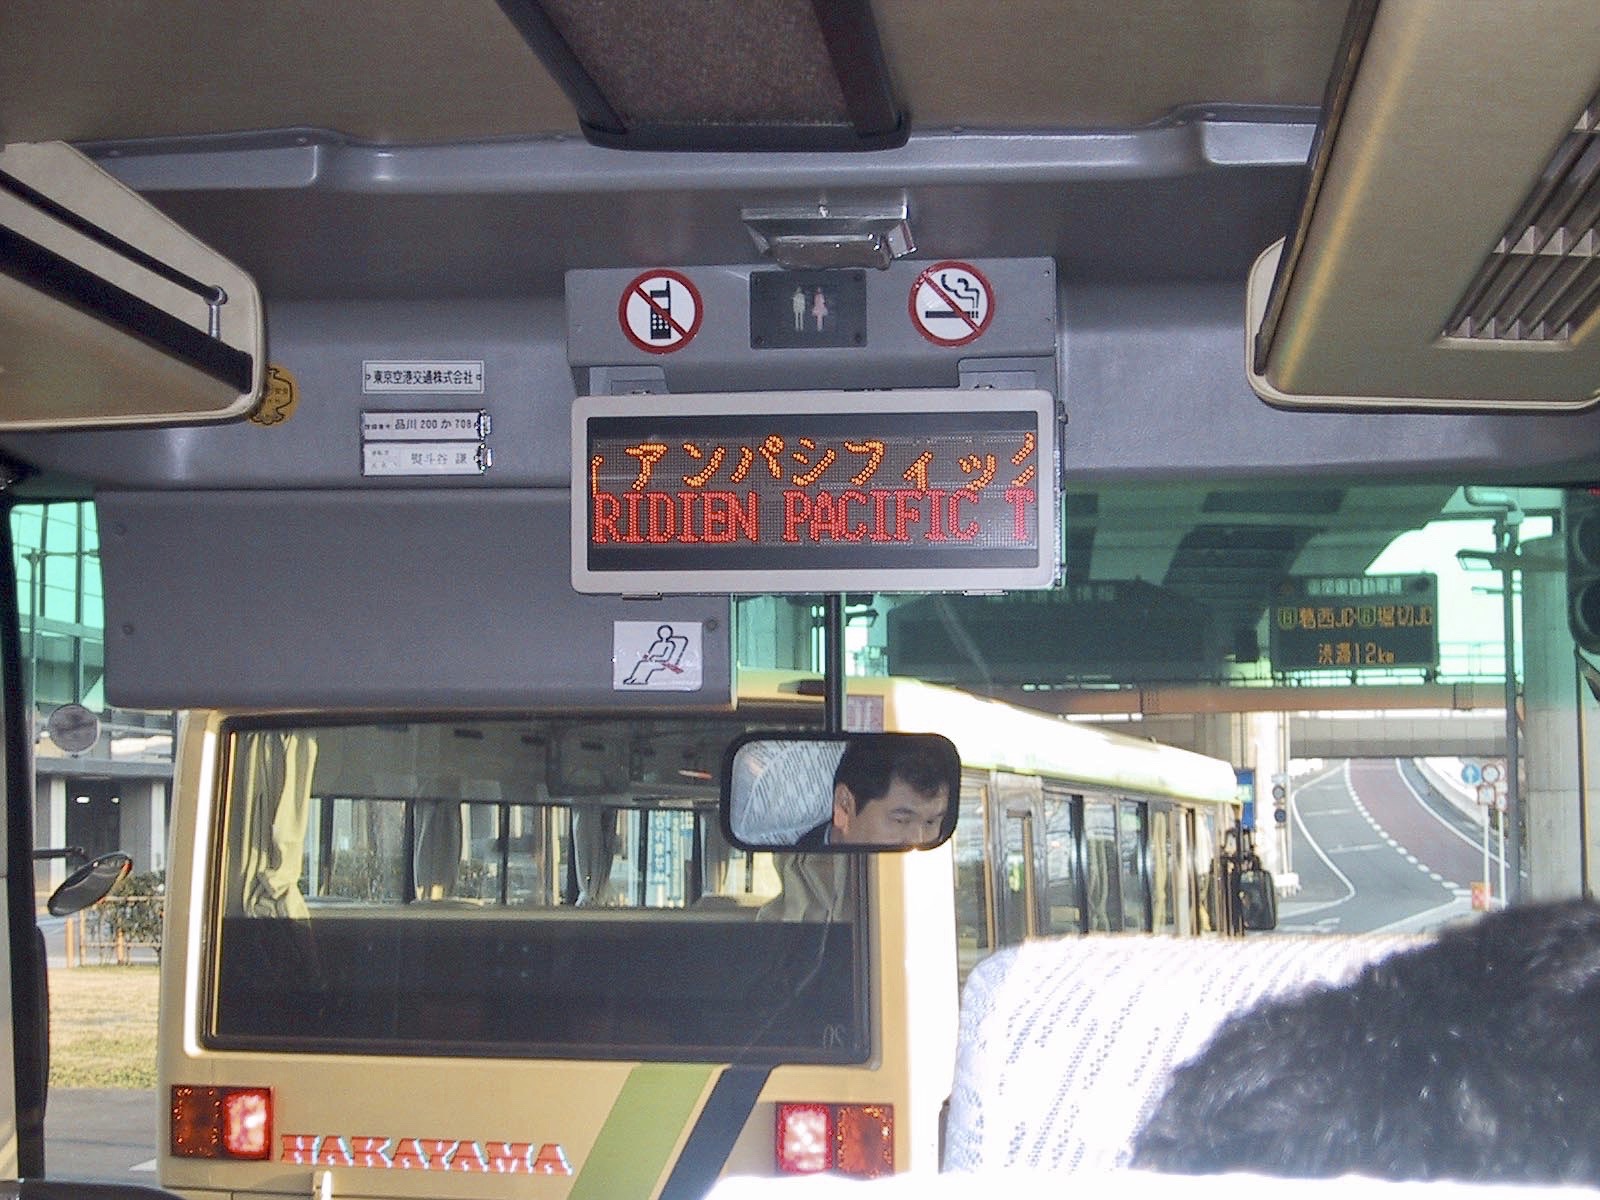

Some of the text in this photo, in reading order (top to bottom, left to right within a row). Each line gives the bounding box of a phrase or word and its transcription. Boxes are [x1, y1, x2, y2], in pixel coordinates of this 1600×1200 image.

[373, 370, 473, 385] 東京空港交通株式会社
[395, 419, 417, 430] 品川
[420, 420, 438, 429] 200
[591, 488, 1035, 543] RIDIEN PACIFIC T
